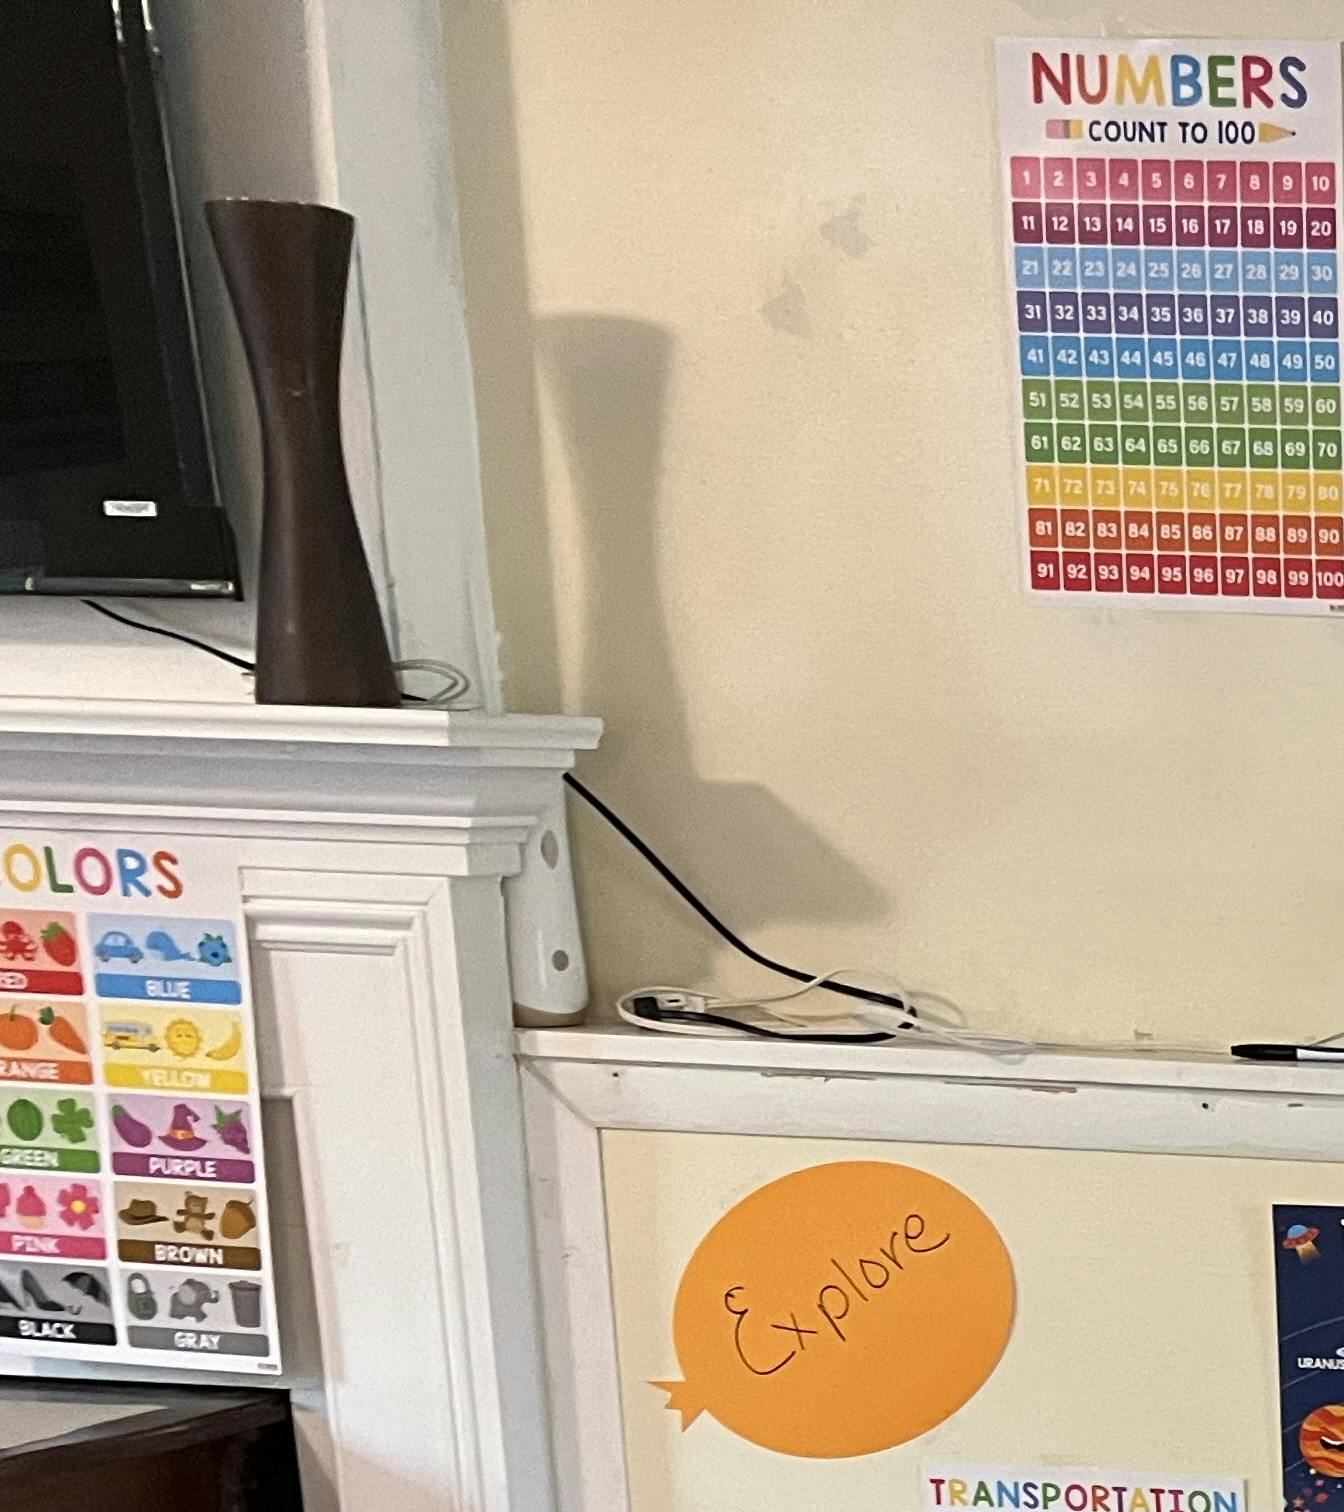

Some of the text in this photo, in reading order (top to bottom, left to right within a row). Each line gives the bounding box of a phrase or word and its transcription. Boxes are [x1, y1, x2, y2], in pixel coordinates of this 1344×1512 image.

[1031, 52, 1308, 109] NUMBERS
[1089, 119, 1255, 144] COUNT TO 100
[1022, 216, 1331, 236] 11 12 13 14 15 16 17 18 19 20
[0, 843, 183, 899] OLORS
[149, 1157, 217, 1178] PURPLE
[155, 1244, 224, 1264] BROWN
[724, 1214, 951, 1376] Explore
[18, 1320, 76, 1339] BLACK
[173, 1332, 221, 1350] GRAY
